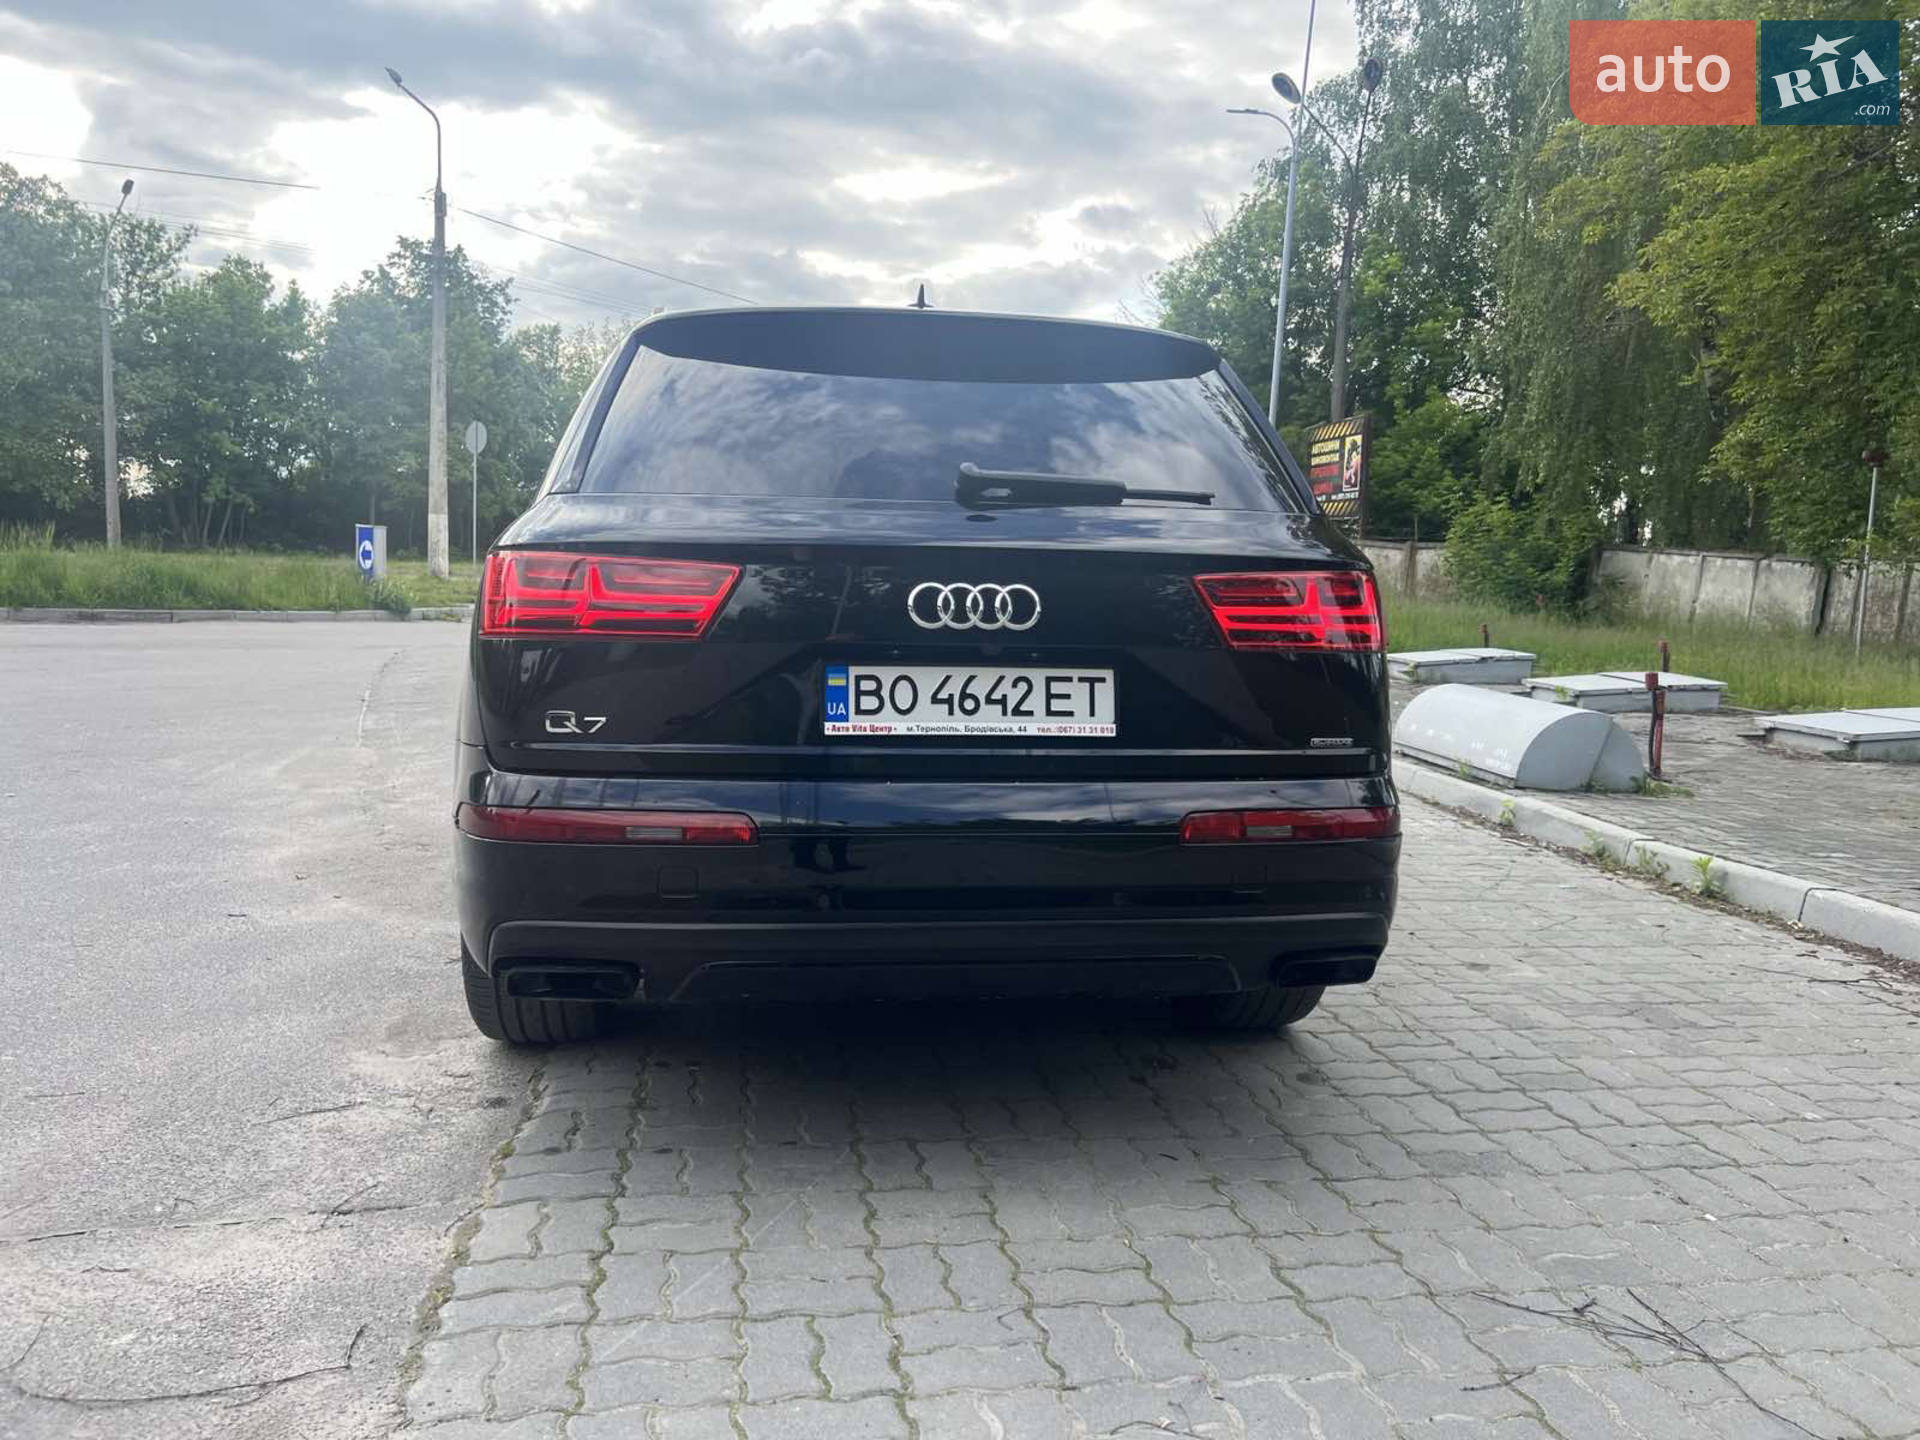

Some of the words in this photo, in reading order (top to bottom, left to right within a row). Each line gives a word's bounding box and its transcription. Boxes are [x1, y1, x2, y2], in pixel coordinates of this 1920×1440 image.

[930, 674, 1034, 717] 4642
[1045, 676, 1107, 717] ET
[827, 702, 846, 715] UA
[545, 709, 607, 733] Q7
[851, 724, 867, 733] Vita
[869, 725, 893, 735] Центр
[1017, 725, 1028, 733] 44
